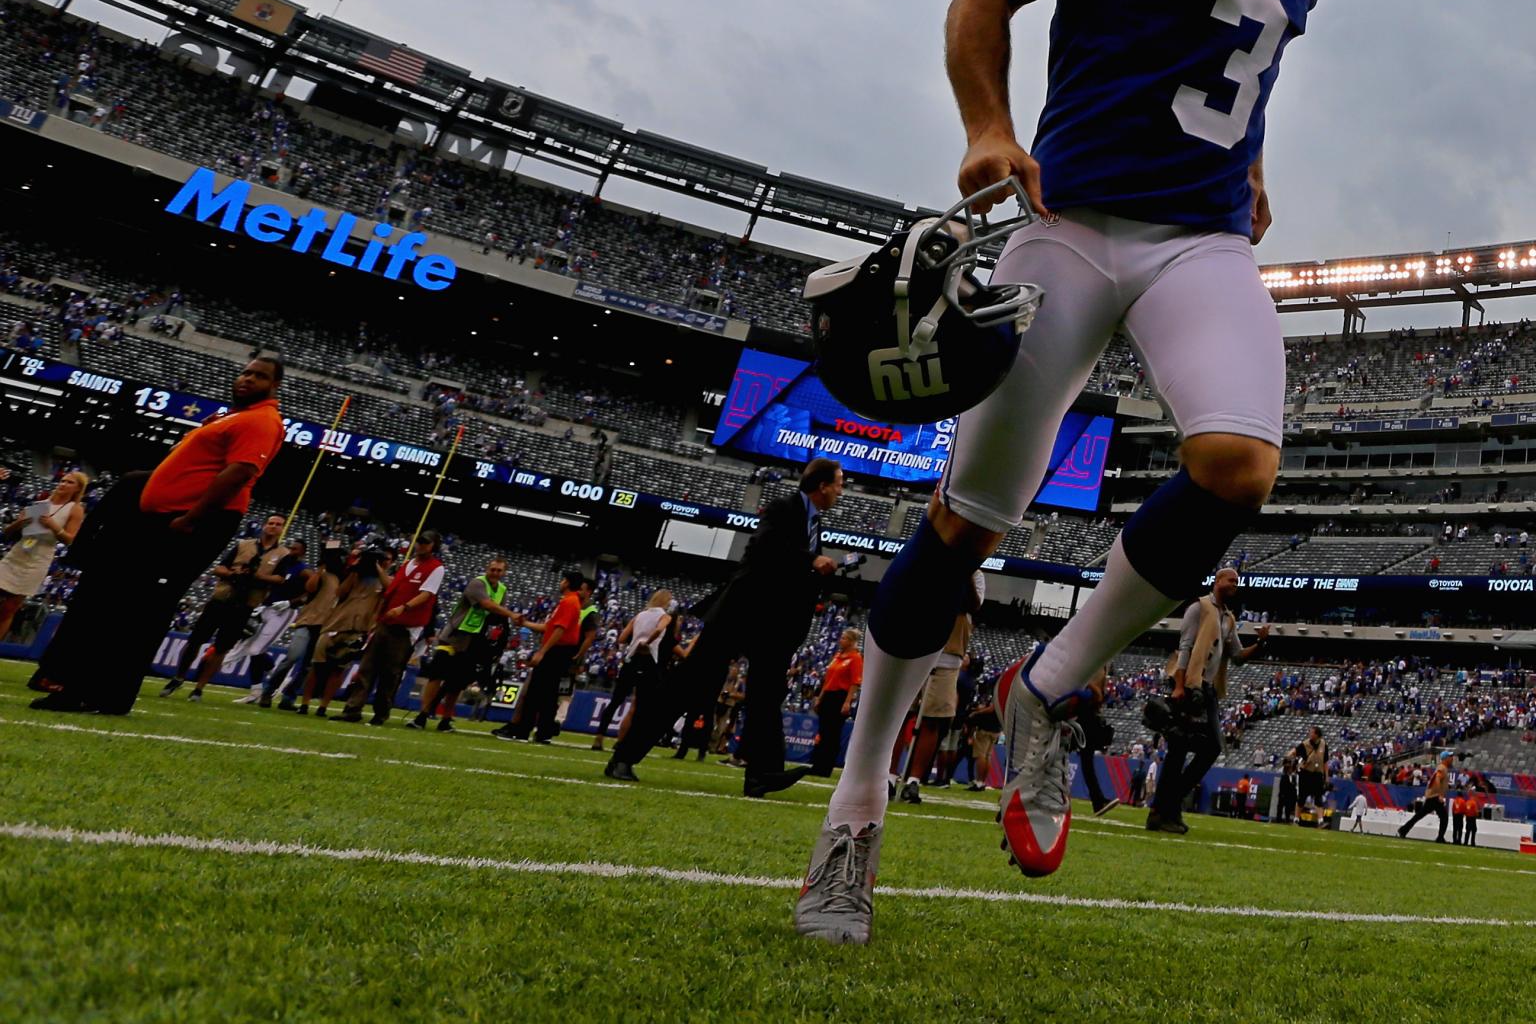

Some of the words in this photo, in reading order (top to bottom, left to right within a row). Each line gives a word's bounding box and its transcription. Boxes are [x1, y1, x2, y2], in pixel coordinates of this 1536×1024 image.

[165, 166, 457, 291] MetLife
[67, 370, 123, 395] SAINTS
[135, 387, 171, 411] 13
[835, 418, 903, 442] TOYOTA
[319, 429, 352, 453] ny
[357, 438, 390, 460] 16
[395, 445, 441, 467] GIANTS
[776, 429, 818, 450] THANK
[819, 436, 846, 456] YOU
[844, 441, 869, 461] FOR
[867, 446, 934, 471] ATTENDING
[539, 476, 551, 488] 4
[560, 480, 603, 502] 0:00
[615, 492, 634, 506] 25
[672, 504, 700, 515] TOYOTA
[820, 530, 875, 550] OFFICIAL
[1248, 577, 1291, 589] VEHICLE
[1292, 577, 1308, 589] OF
[1313, 578, 1333, 590] THE
[1335, 578, 1359, 590] GIANTS
[1488, 578, 1533, 591] TOYOTA
